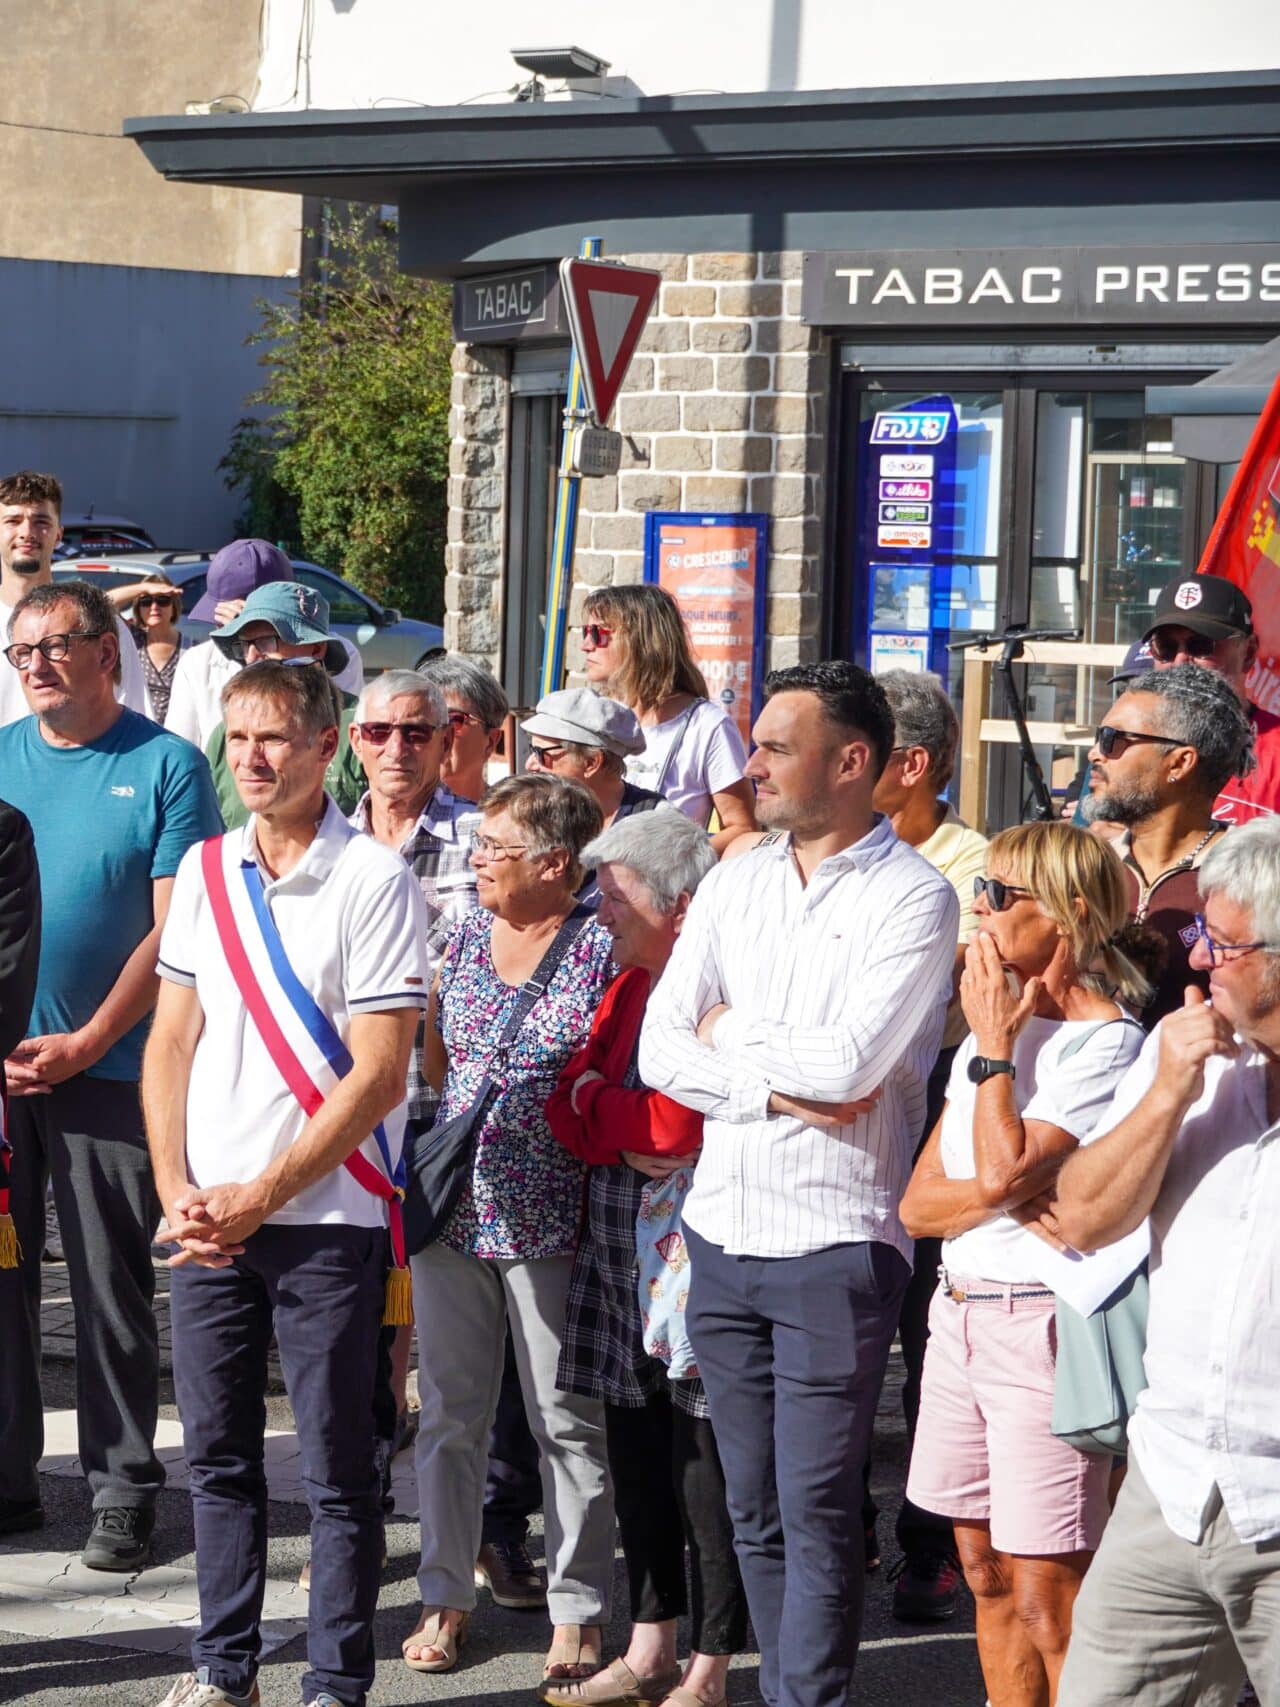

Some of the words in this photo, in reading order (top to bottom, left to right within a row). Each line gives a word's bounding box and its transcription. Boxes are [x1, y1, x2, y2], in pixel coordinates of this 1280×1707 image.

[834, 267, 1062, 305] TABAC
[475, 280, 532, 321] TABAC
[876, 418, 920, 438] FDJ
[894, 530, 925, 545] amigo
[683, 548, 749, 569] CRESCENDO
